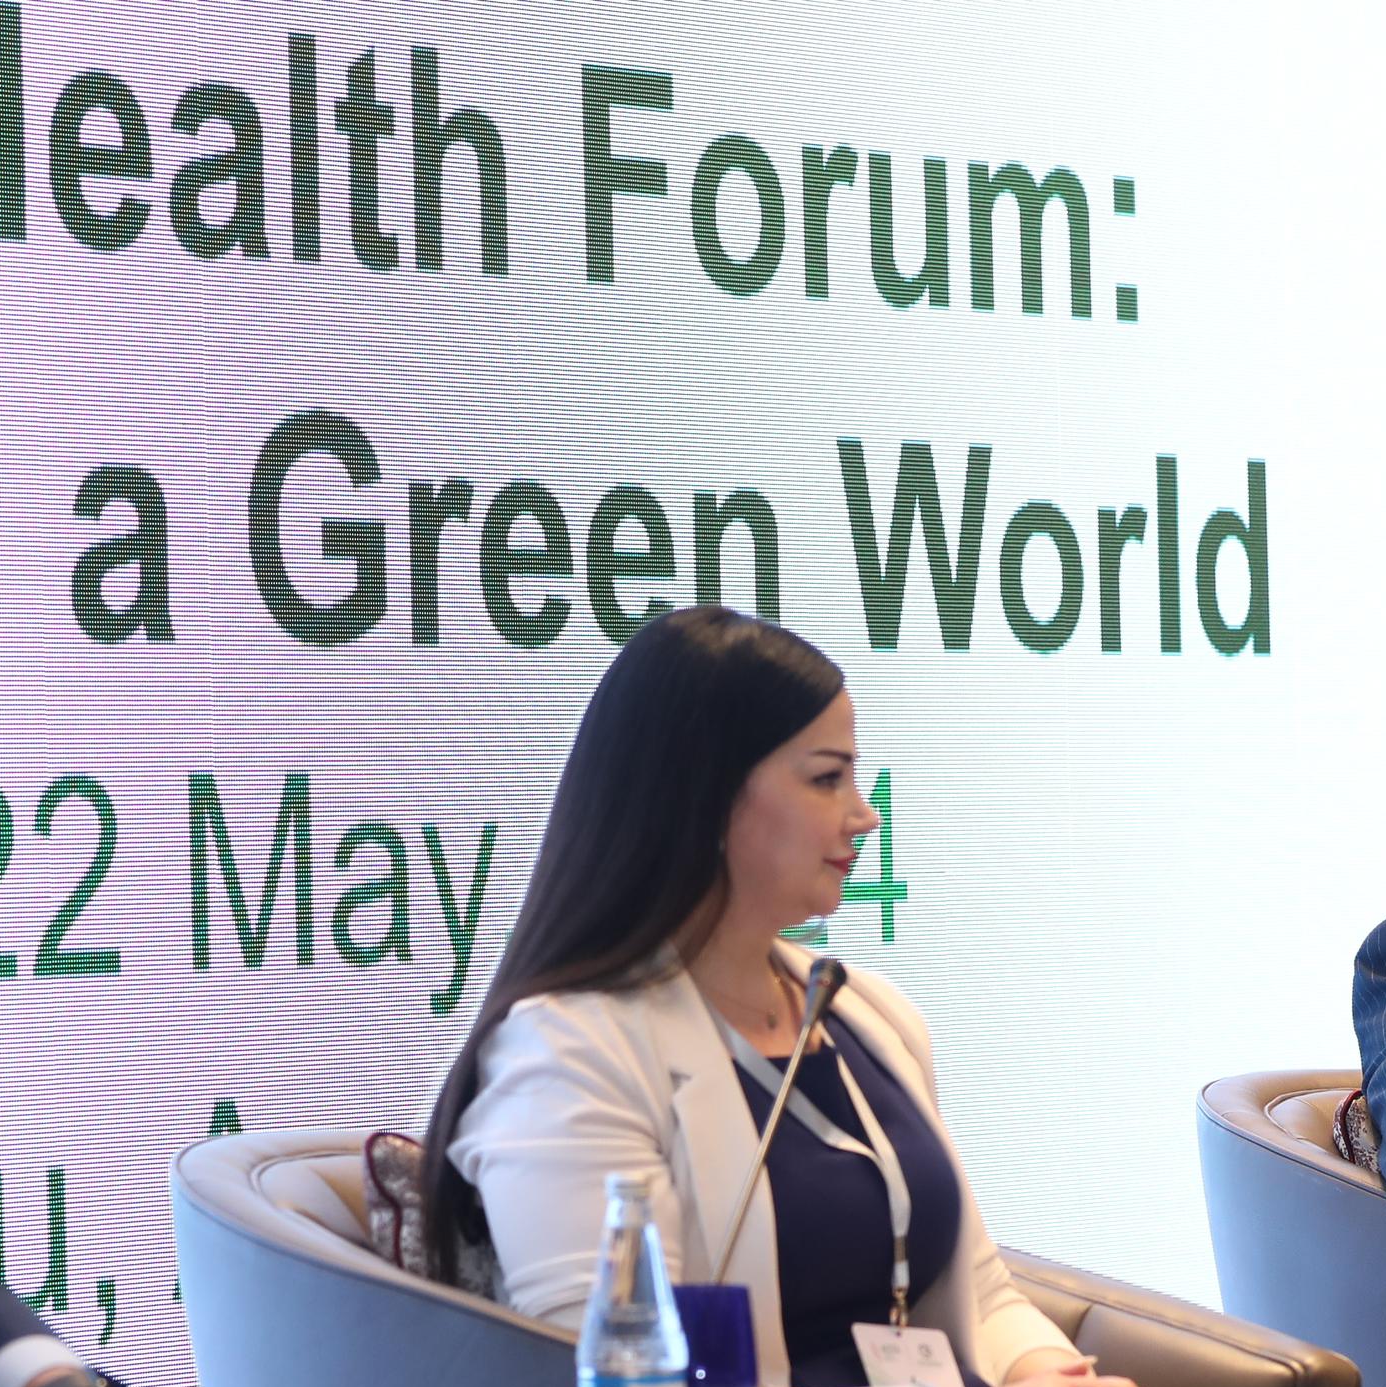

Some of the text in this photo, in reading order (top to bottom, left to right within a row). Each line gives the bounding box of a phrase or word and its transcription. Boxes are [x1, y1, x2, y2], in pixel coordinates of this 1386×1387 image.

[581, 63, 1138, 323] Forum:
[70, 462, 176, 645] a
[247, 407, 780, 648] Green
[835, 436, 1271, 657] World
[188, 769, 498, 1018] May
